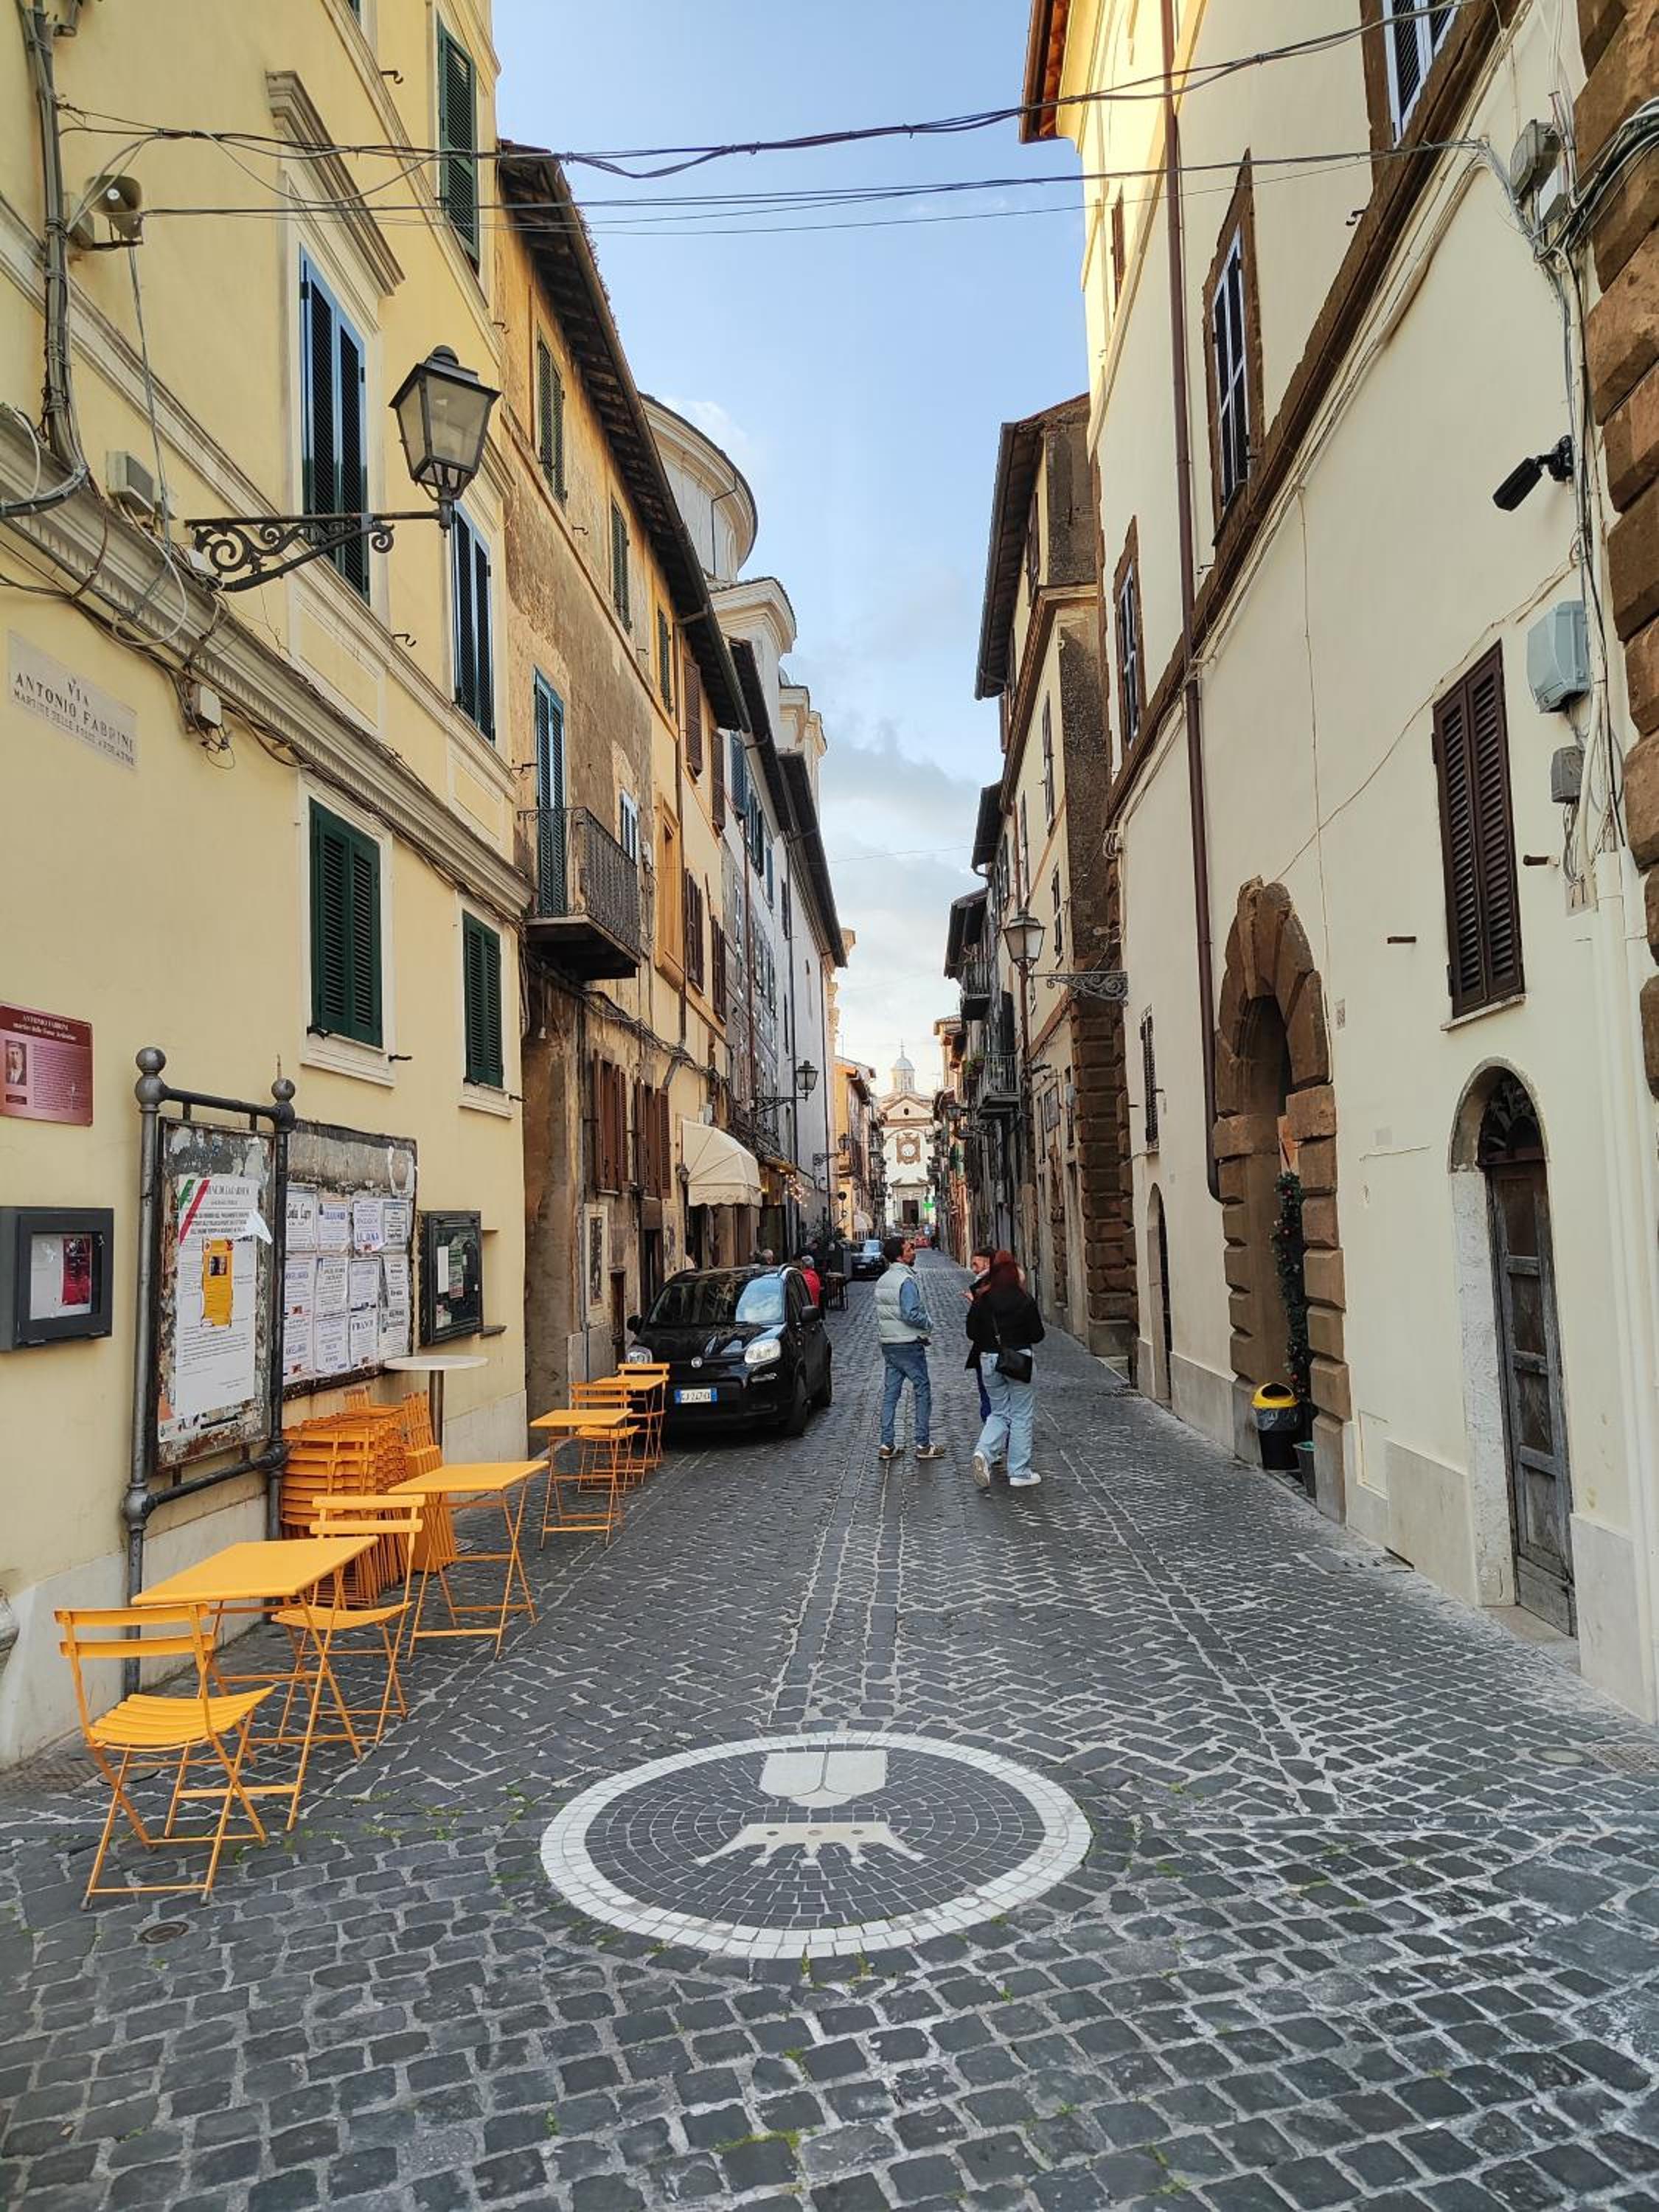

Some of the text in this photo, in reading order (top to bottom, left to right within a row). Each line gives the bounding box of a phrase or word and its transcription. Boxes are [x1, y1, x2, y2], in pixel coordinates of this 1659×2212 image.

[16, 672, 133, 752] ANTONIO FABRINI
[68, 678, 88, 706] VIA
